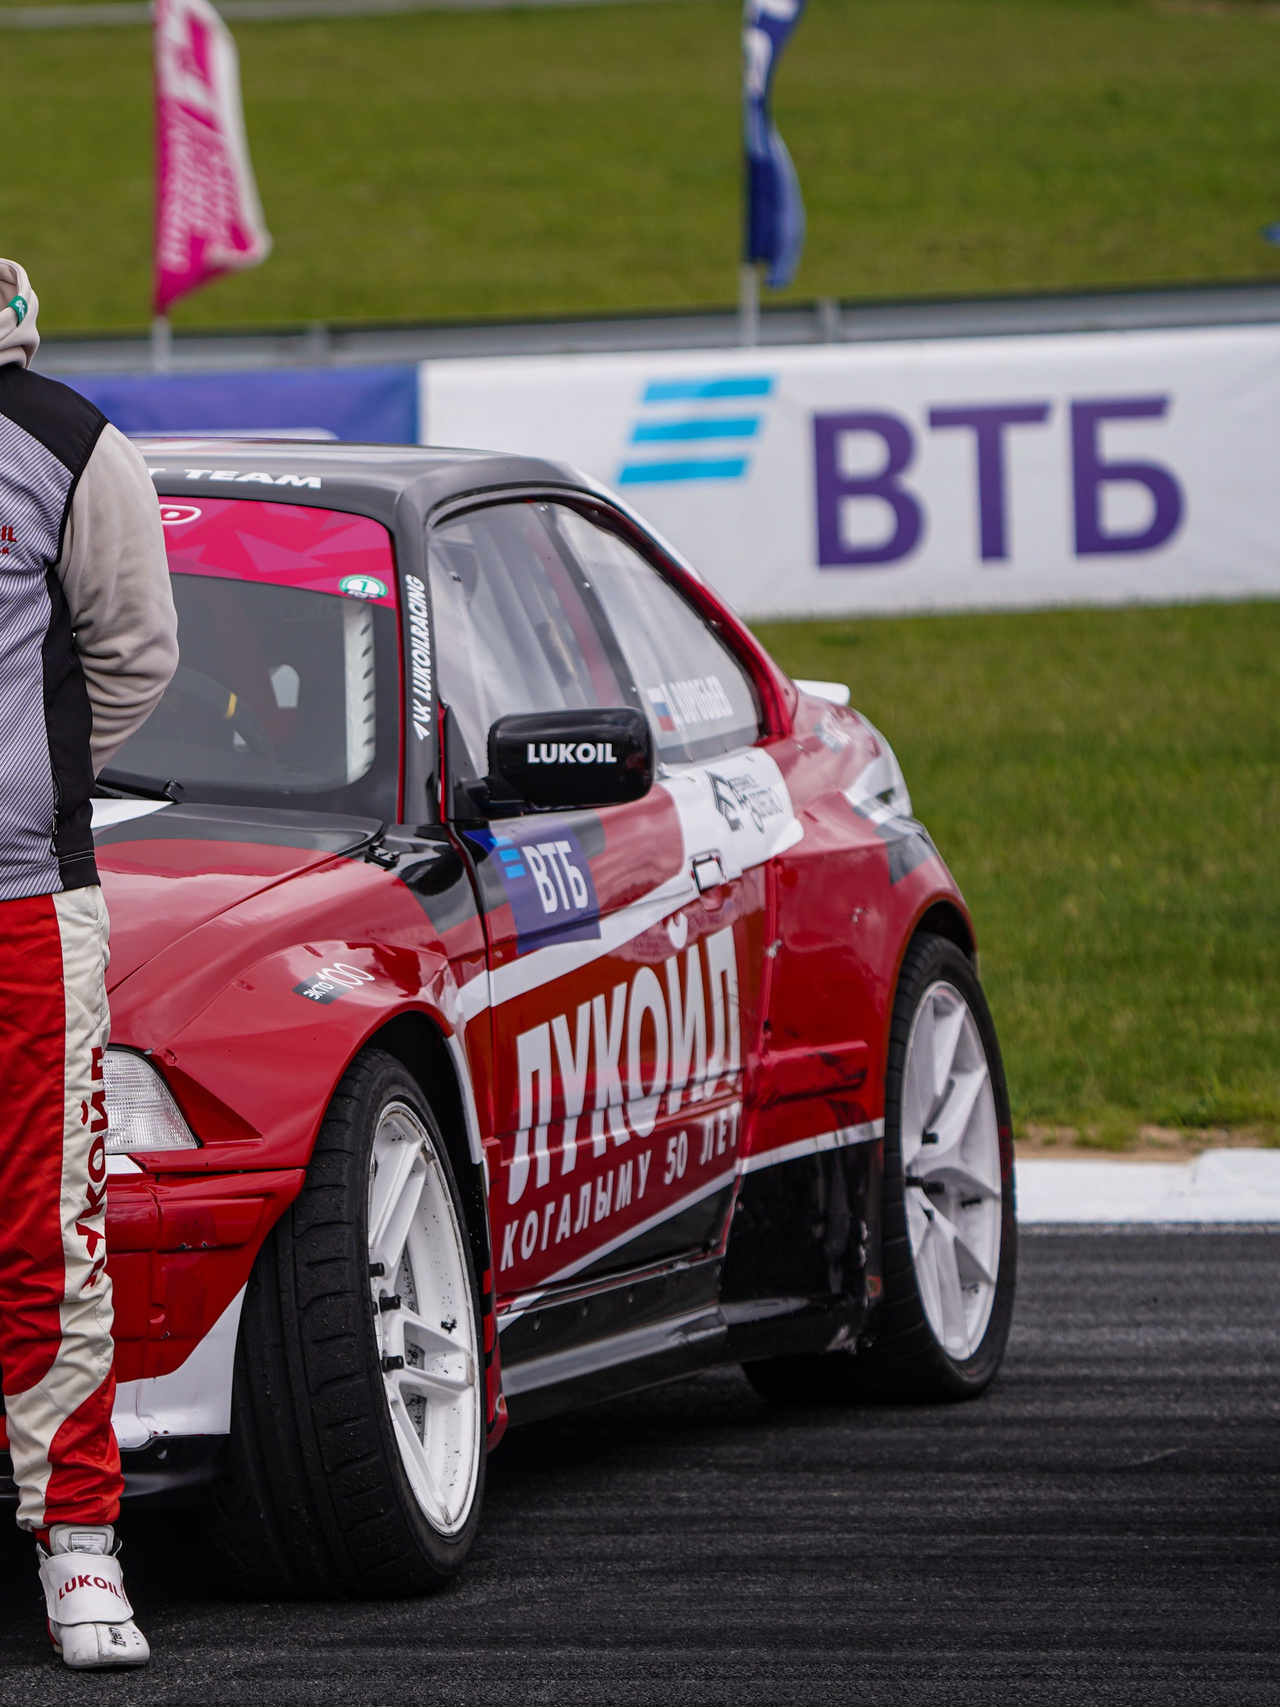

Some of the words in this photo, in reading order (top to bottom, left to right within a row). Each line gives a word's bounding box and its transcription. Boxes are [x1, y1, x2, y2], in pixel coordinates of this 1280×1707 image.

[184, 468, 321, 489] TEAM
[813, 393, 1187, 571] ВТБ
[527, 741, 618, 765] LUKOIL
[522, 840, 589, 914] ВТБ
[316, 962, 376, 989] 100
[303, 981, 335, 1000] ЭКТО
[507, 912, 741, 1205] ЛУКОЙЛ
[500, 1150, 652, 1271] КОГАЛЫМУ
[664, 1131, 688, 1186] 50
[700, 1100, 741, 1166] ЛЕТ
[58, 1574, 122, 1600] LUKOIL
